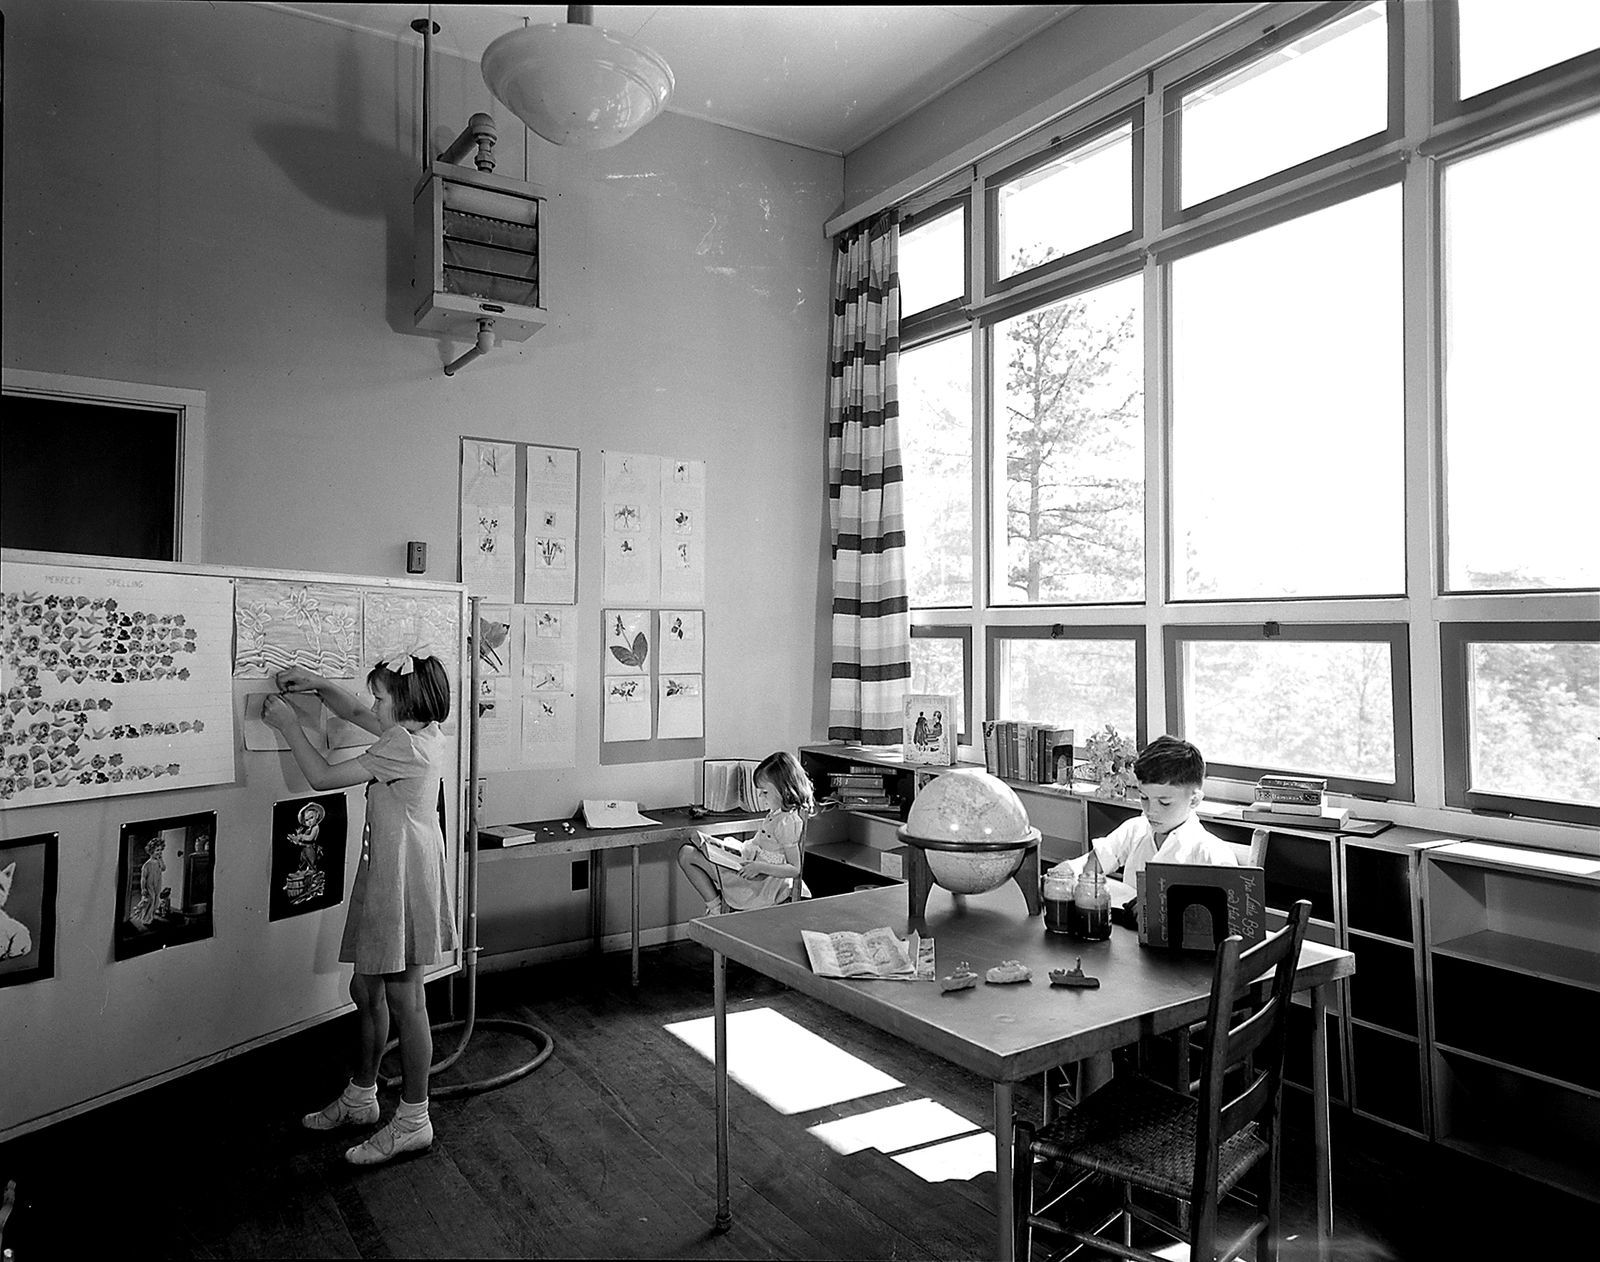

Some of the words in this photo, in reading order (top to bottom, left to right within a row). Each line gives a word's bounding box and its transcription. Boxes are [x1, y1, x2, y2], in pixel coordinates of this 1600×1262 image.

[44, 575, 82, 585] PERFECT
[106, 578, 144, 589] SPELLING
[1239, 875, 1256, 892] The
[1245, 893, 1261, 917] Little
[1242, 918, 1259, 939] Boy
